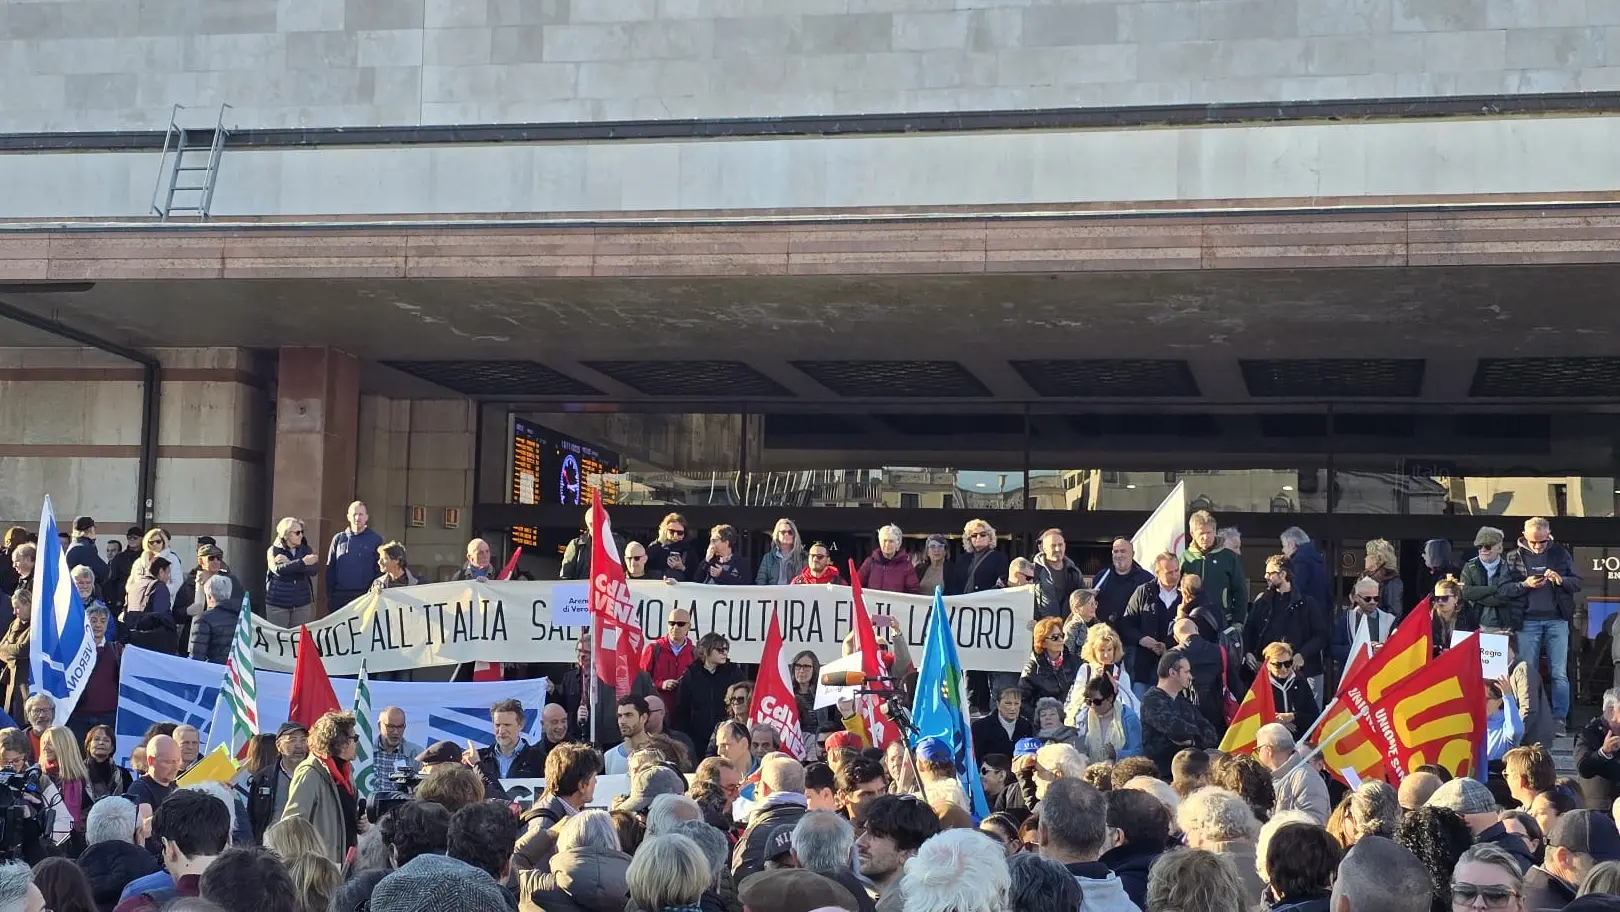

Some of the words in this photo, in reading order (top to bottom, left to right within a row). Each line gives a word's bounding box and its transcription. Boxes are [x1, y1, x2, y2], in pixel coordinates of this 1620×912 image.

[254, 626, 270, 653] A
[276, 616, 362, 659] FENICE
[711, 599, 823, 643] CULTURA
[571, 605, 589, 613] Vero
[1375, 707, 1399, 758] UNIONE
